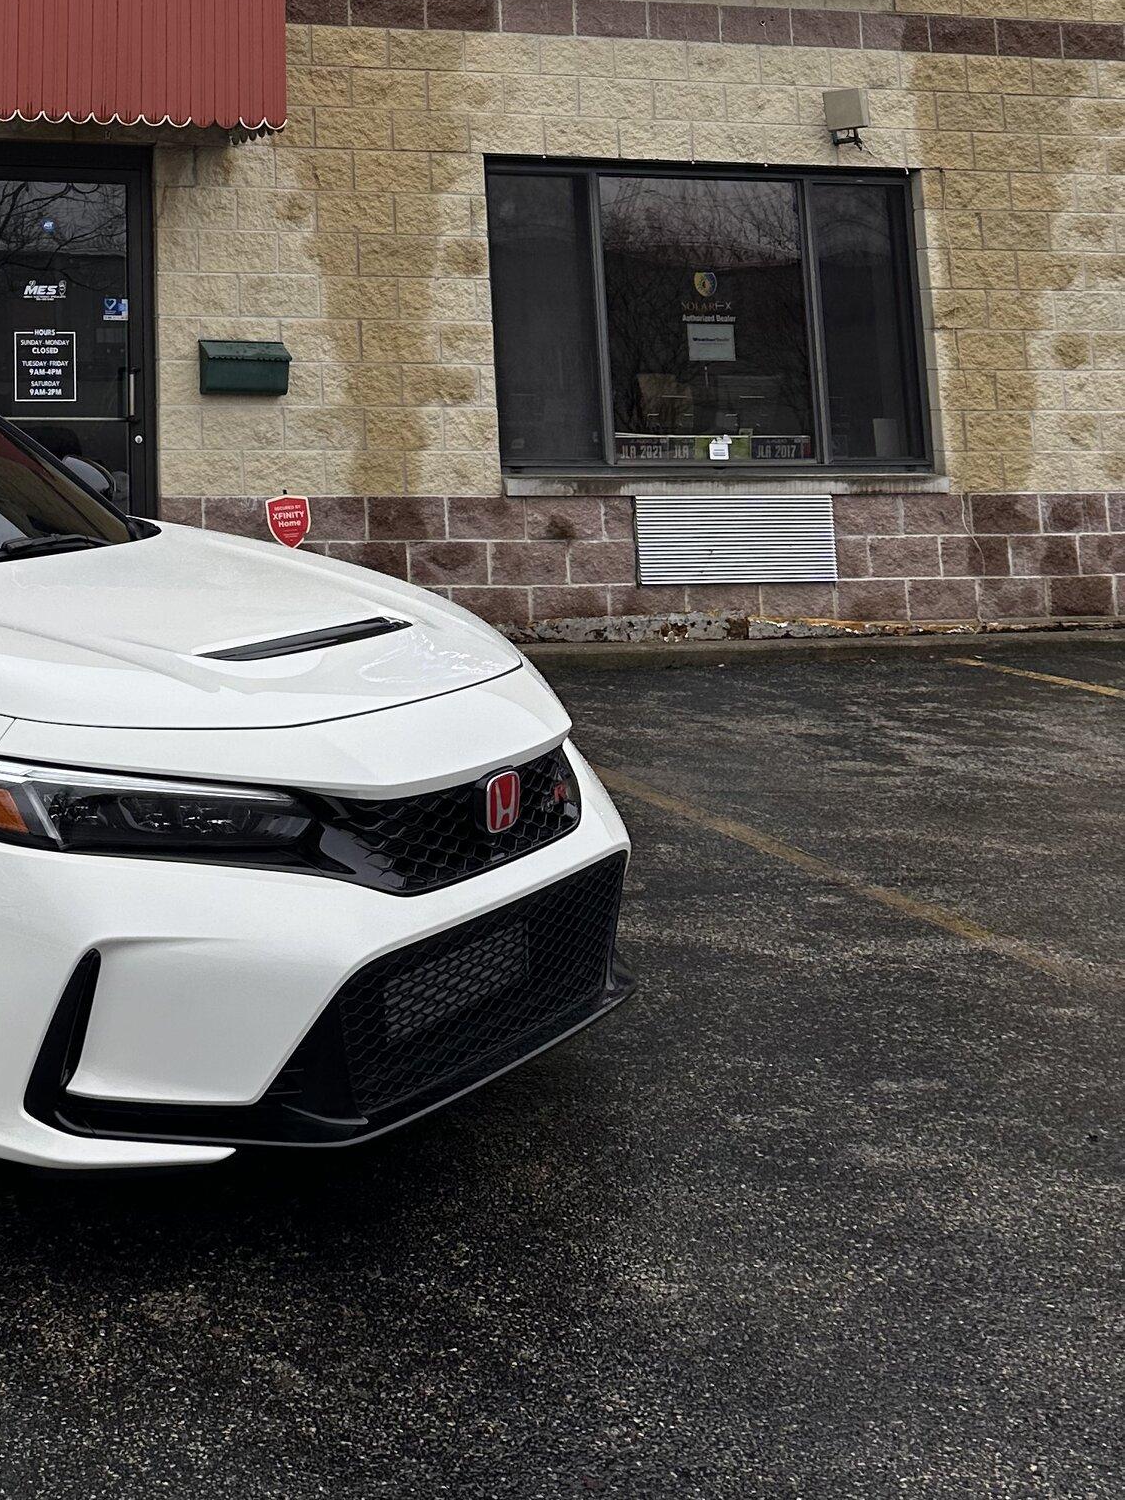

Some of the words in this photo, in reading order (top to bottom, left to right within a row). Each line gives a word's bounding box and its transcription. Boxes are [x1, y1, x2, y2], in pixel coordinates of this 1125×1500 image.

[24, 285, 58, 295] MES
[682, 314, 715, 322] Authorized
[34, 328, 56, 336] HOURS
[29, 368, 62, 376] 9AM-4PM
[29, 388, 62, 396] 9AM-2PM
[272, 510, 304, 520] XFINITY
[278, 520, 302, 528] Home
